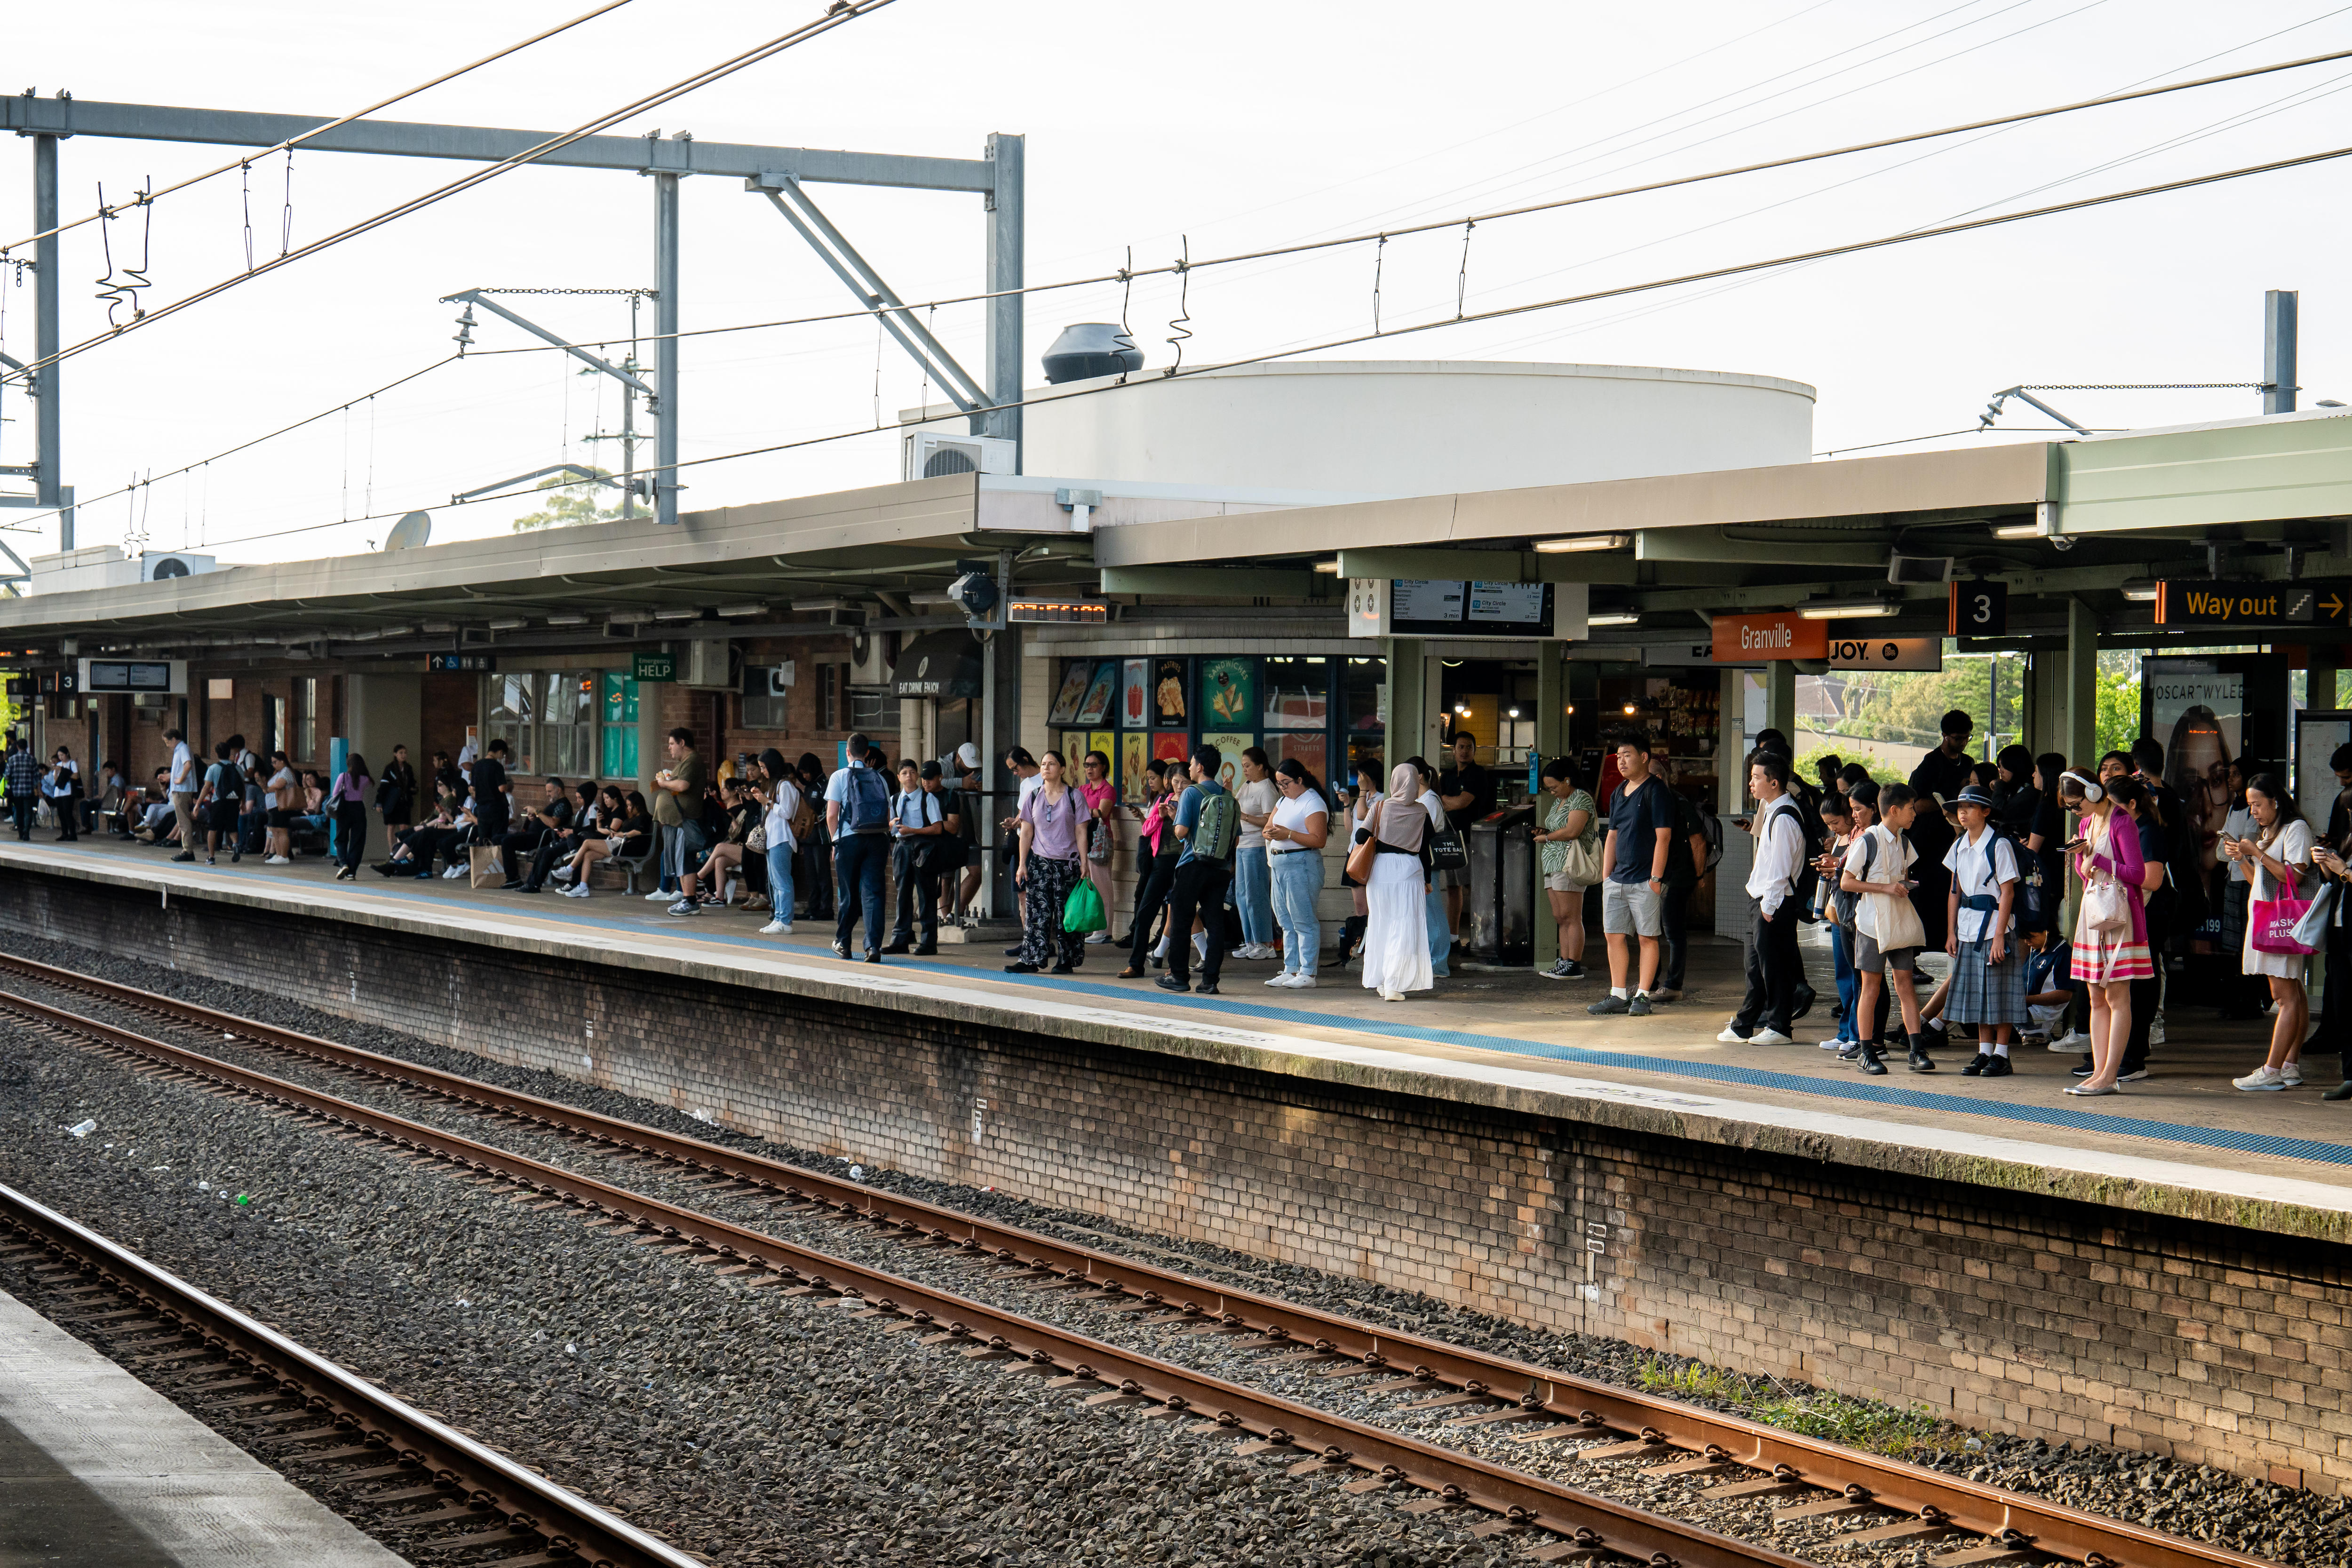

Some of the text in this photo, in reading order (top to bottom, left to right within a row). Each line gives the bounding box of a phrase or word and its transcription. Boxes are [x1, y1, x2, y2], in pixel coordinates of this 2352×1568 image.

[1973, 595, 1991, 623] 3
[2187, 592, 2277, 620] Way out
[1741, 622, 1792, 649] Granville
[638, 665, 670, 677] HELP
[1160, 661, 1181, 673] PASTRIES
[1208, 660, 1248, 680] SANDWICHES
[64, 677, 72, 688] 3
[899, 682, 939, 694] EAT DRINK ENJOY
[2156, 685, 2194, 700] OSCAR
[1068, 734, 1081, 746] DONUTS
[1095, 735, 1110, 748] BURGERS
[1129, 735, 1140, 745] WRAPS
[1216, 736, 1240, 747] COFFEE
[2205, 919, 2220, 932] 199
[2269, 918, 2295, 928] MASK
[2269, 930, 2291, 938] PLUS
